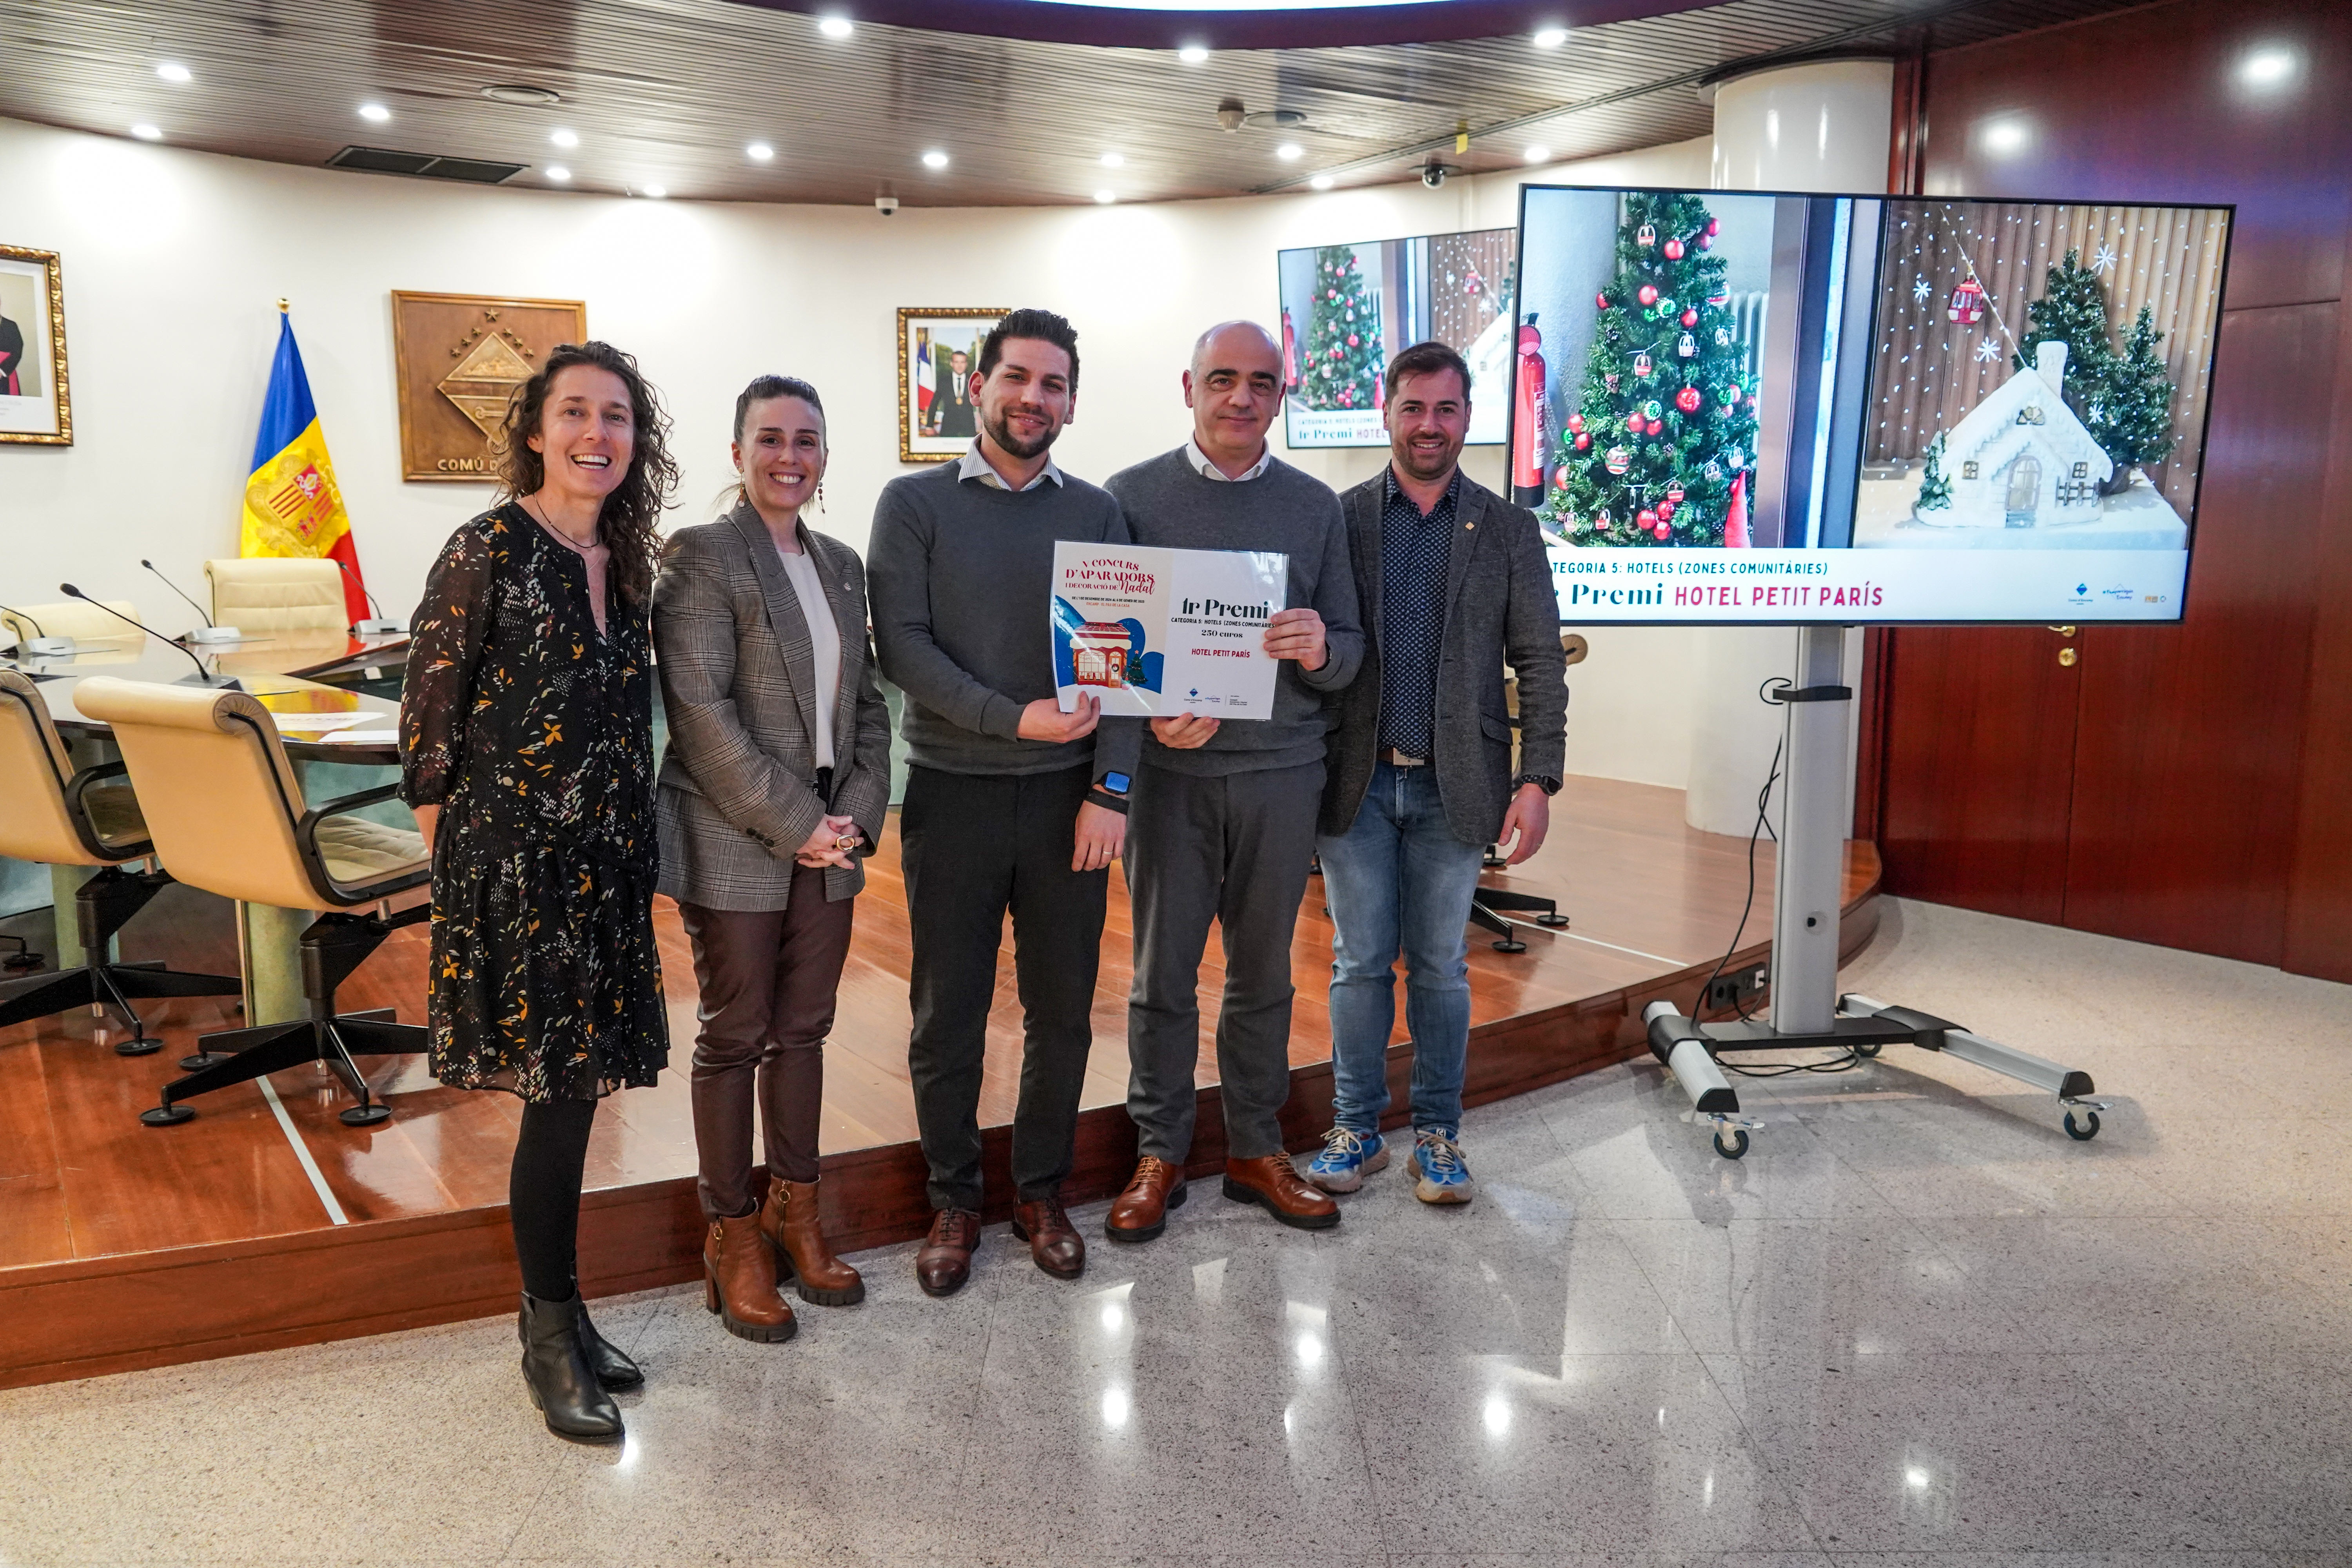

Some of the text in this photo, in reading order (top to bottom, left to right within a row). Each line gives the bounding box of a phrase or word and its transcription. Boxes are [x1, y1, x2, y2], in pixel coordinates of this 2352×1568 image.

[1314, 428, 1352, 439] Premi
[1357, 429, 1386, 438] HOTEL
[437, 456, 484, 471] COMÚ
[1092, 559, 1139, 571] CONCURS
[1553, 560, 1828, 575] TEGORIA 5: HOTELS (ZONES COMUNITÀRIES)
[1119, 579, 1155, 595] Nadal
[1572, 581, 1883, 606] Premi HOTEL PETIT PARÍS
[1182, 598, 1269, 619] 1r Premi
[1232, 650, 1250, 658] PARÍS
